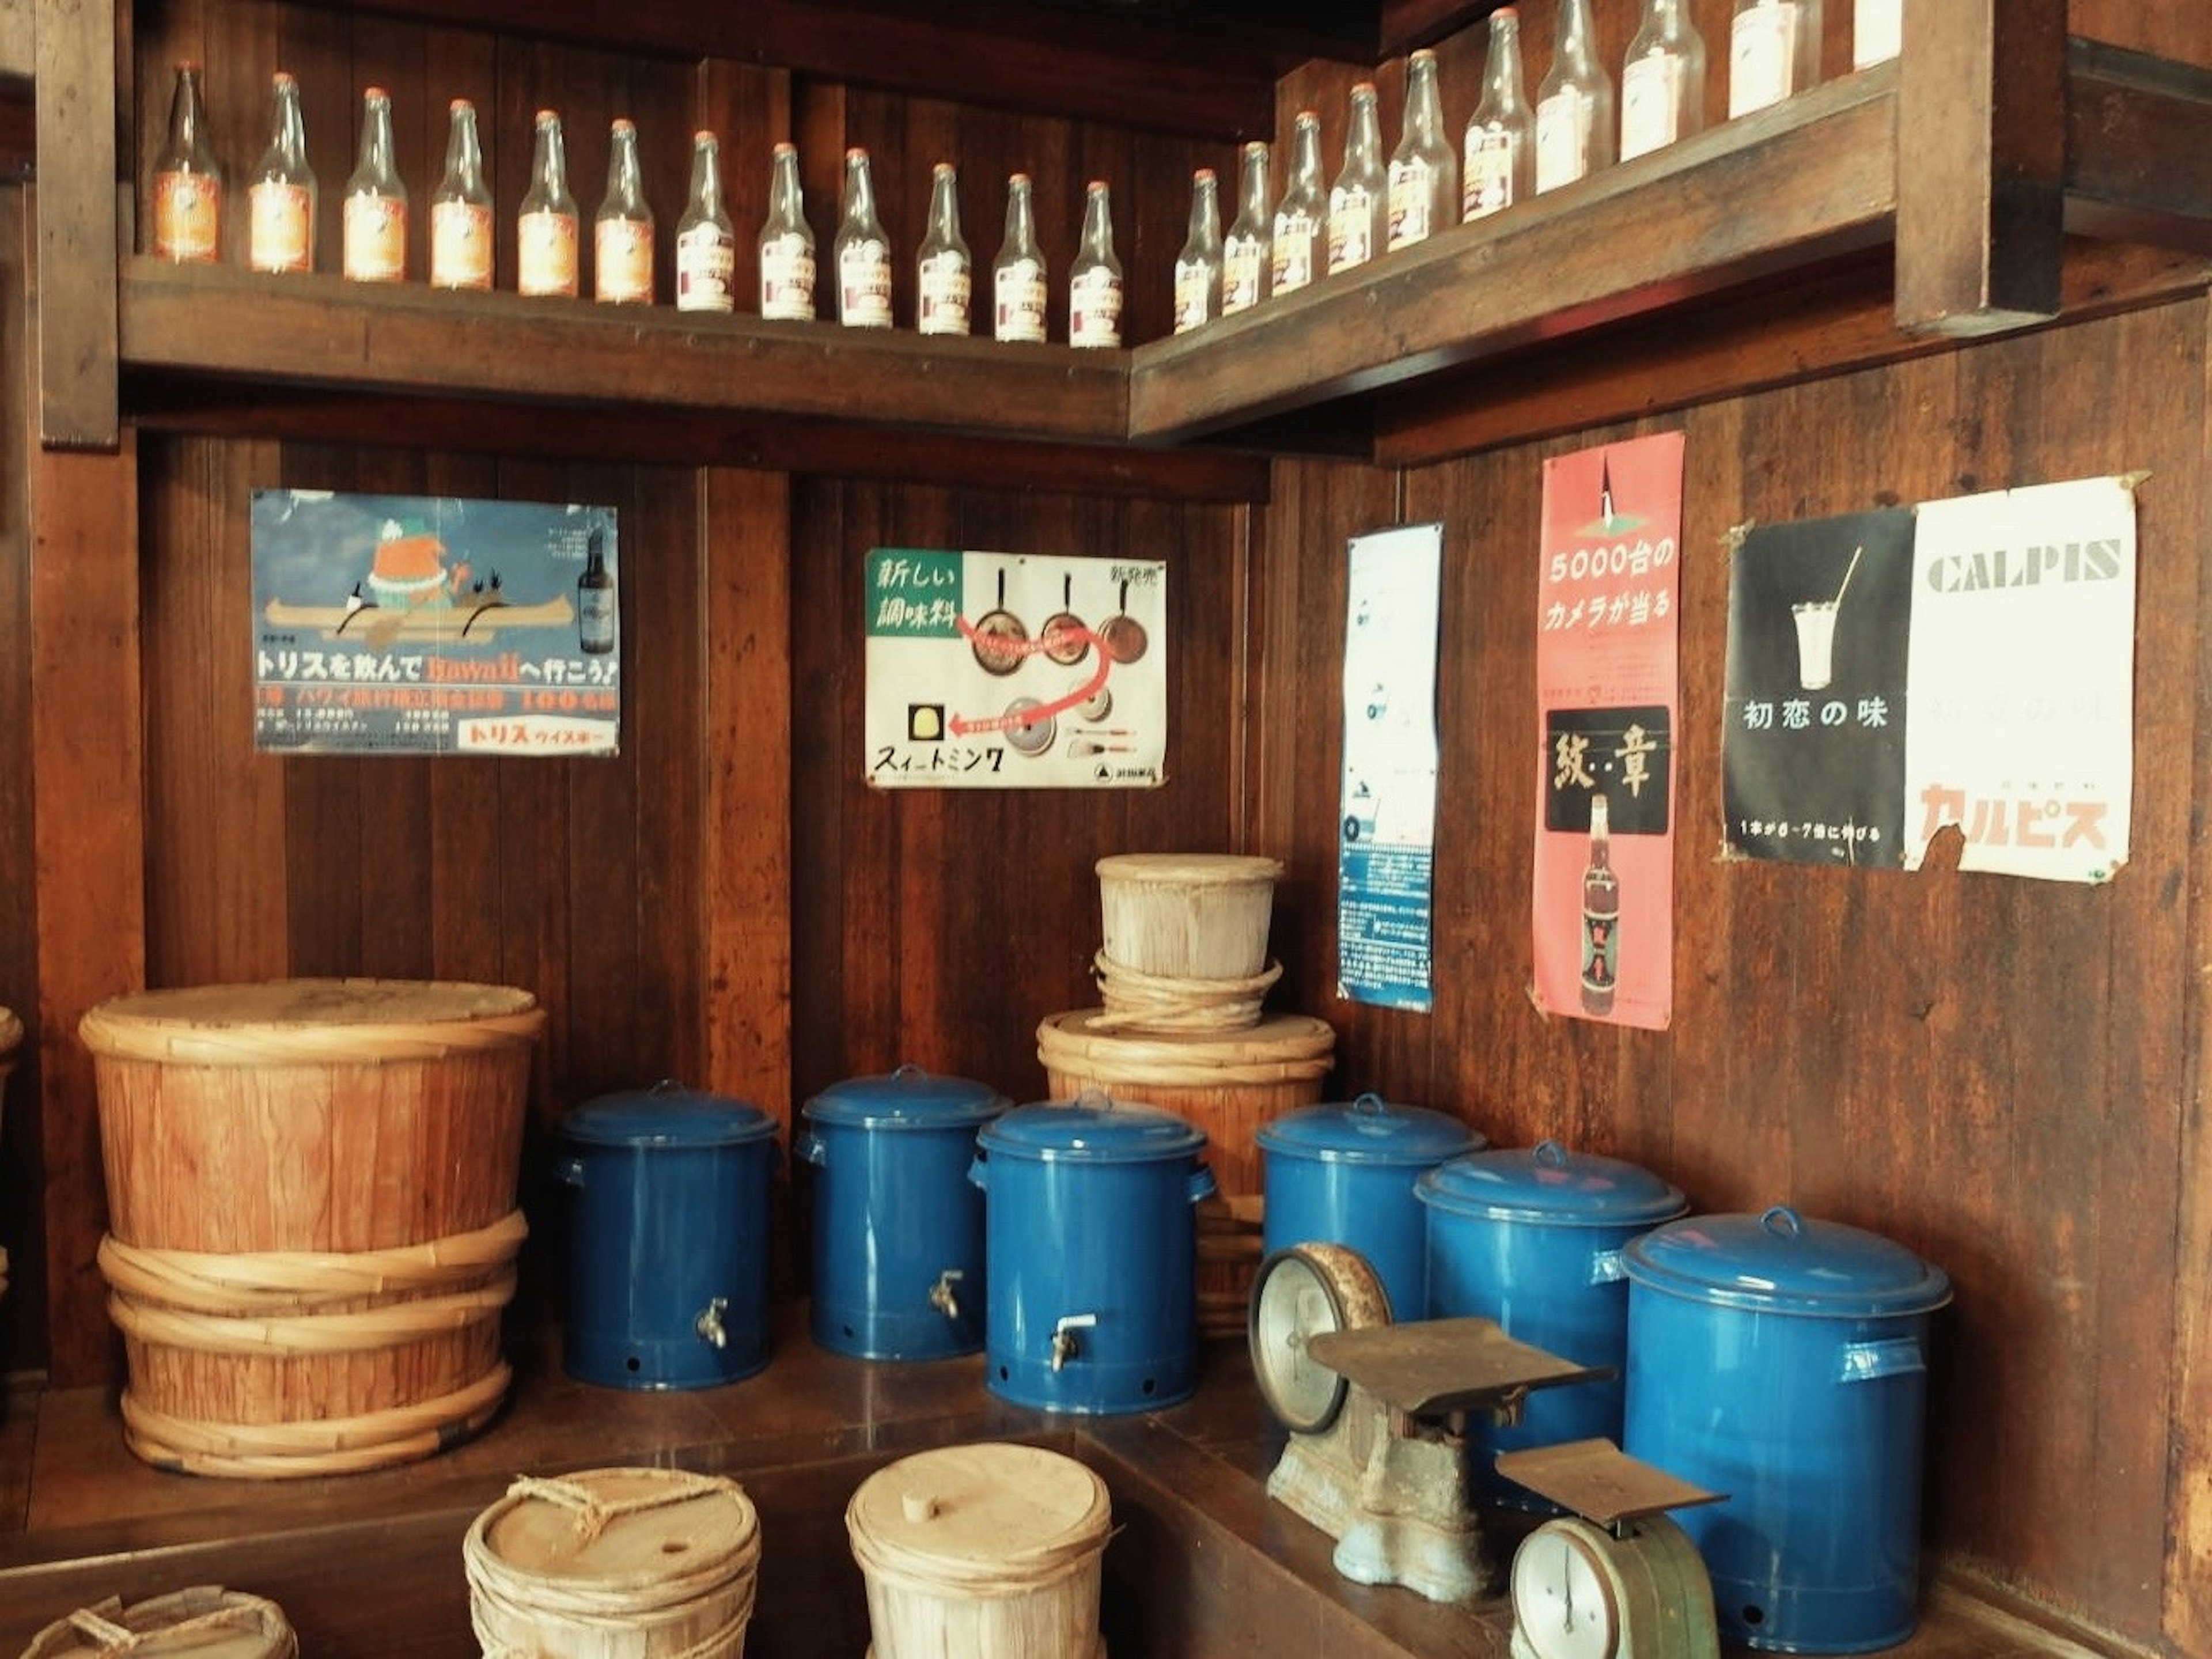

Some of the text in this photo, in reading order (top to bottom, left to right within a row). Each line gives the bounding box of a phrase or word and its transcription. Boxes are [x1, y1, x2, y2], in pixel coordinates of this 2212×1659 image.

[877, 558, 955, 589] 新しい
[1550, 537, 1675, 583] 5000台の
[1927, 539, 2121, 593] CALPIS
[877, 597, 957, 630] 調味料
[1544, 588, 1669, 630] カメラが当る
[1744, 696, 1888, 729] 初恋の味
[1921, 784, 2108, 849] カルピス
